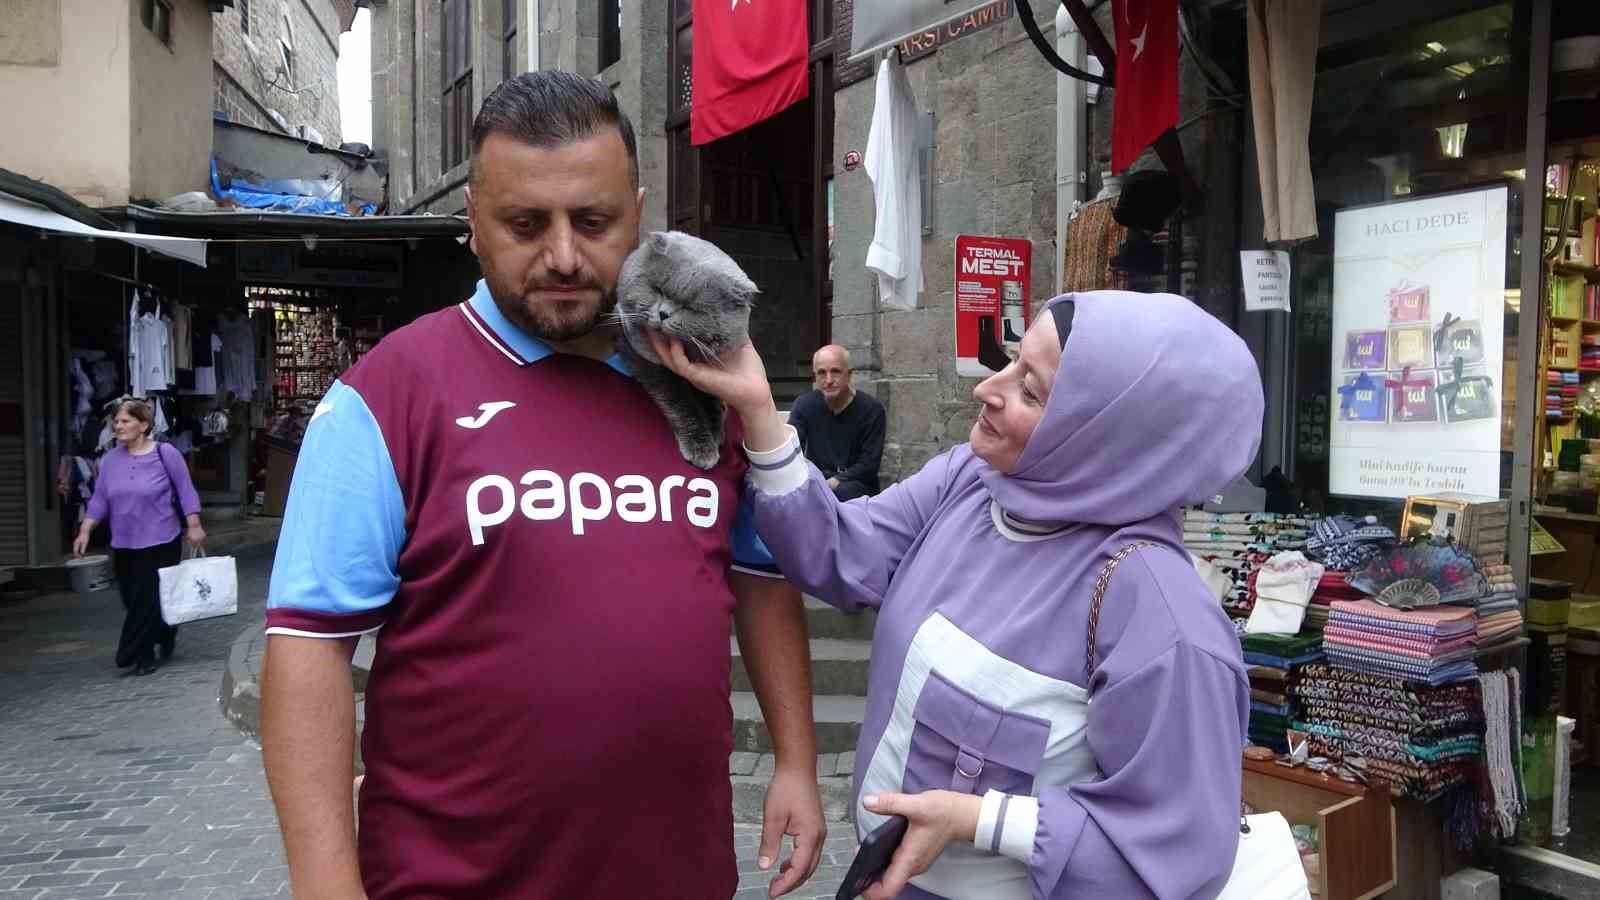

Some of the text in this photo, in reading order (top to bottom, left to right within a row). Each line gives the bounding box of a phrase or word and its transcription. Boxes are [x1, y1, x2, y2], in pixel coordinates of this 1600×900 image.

[1366, 211, 1470, 237] HACI DEDE
[966, 246, 1021, 260] TERMAL
[962, 257, 1025, 277] MEST
[466, 469, 719, 546] papara
